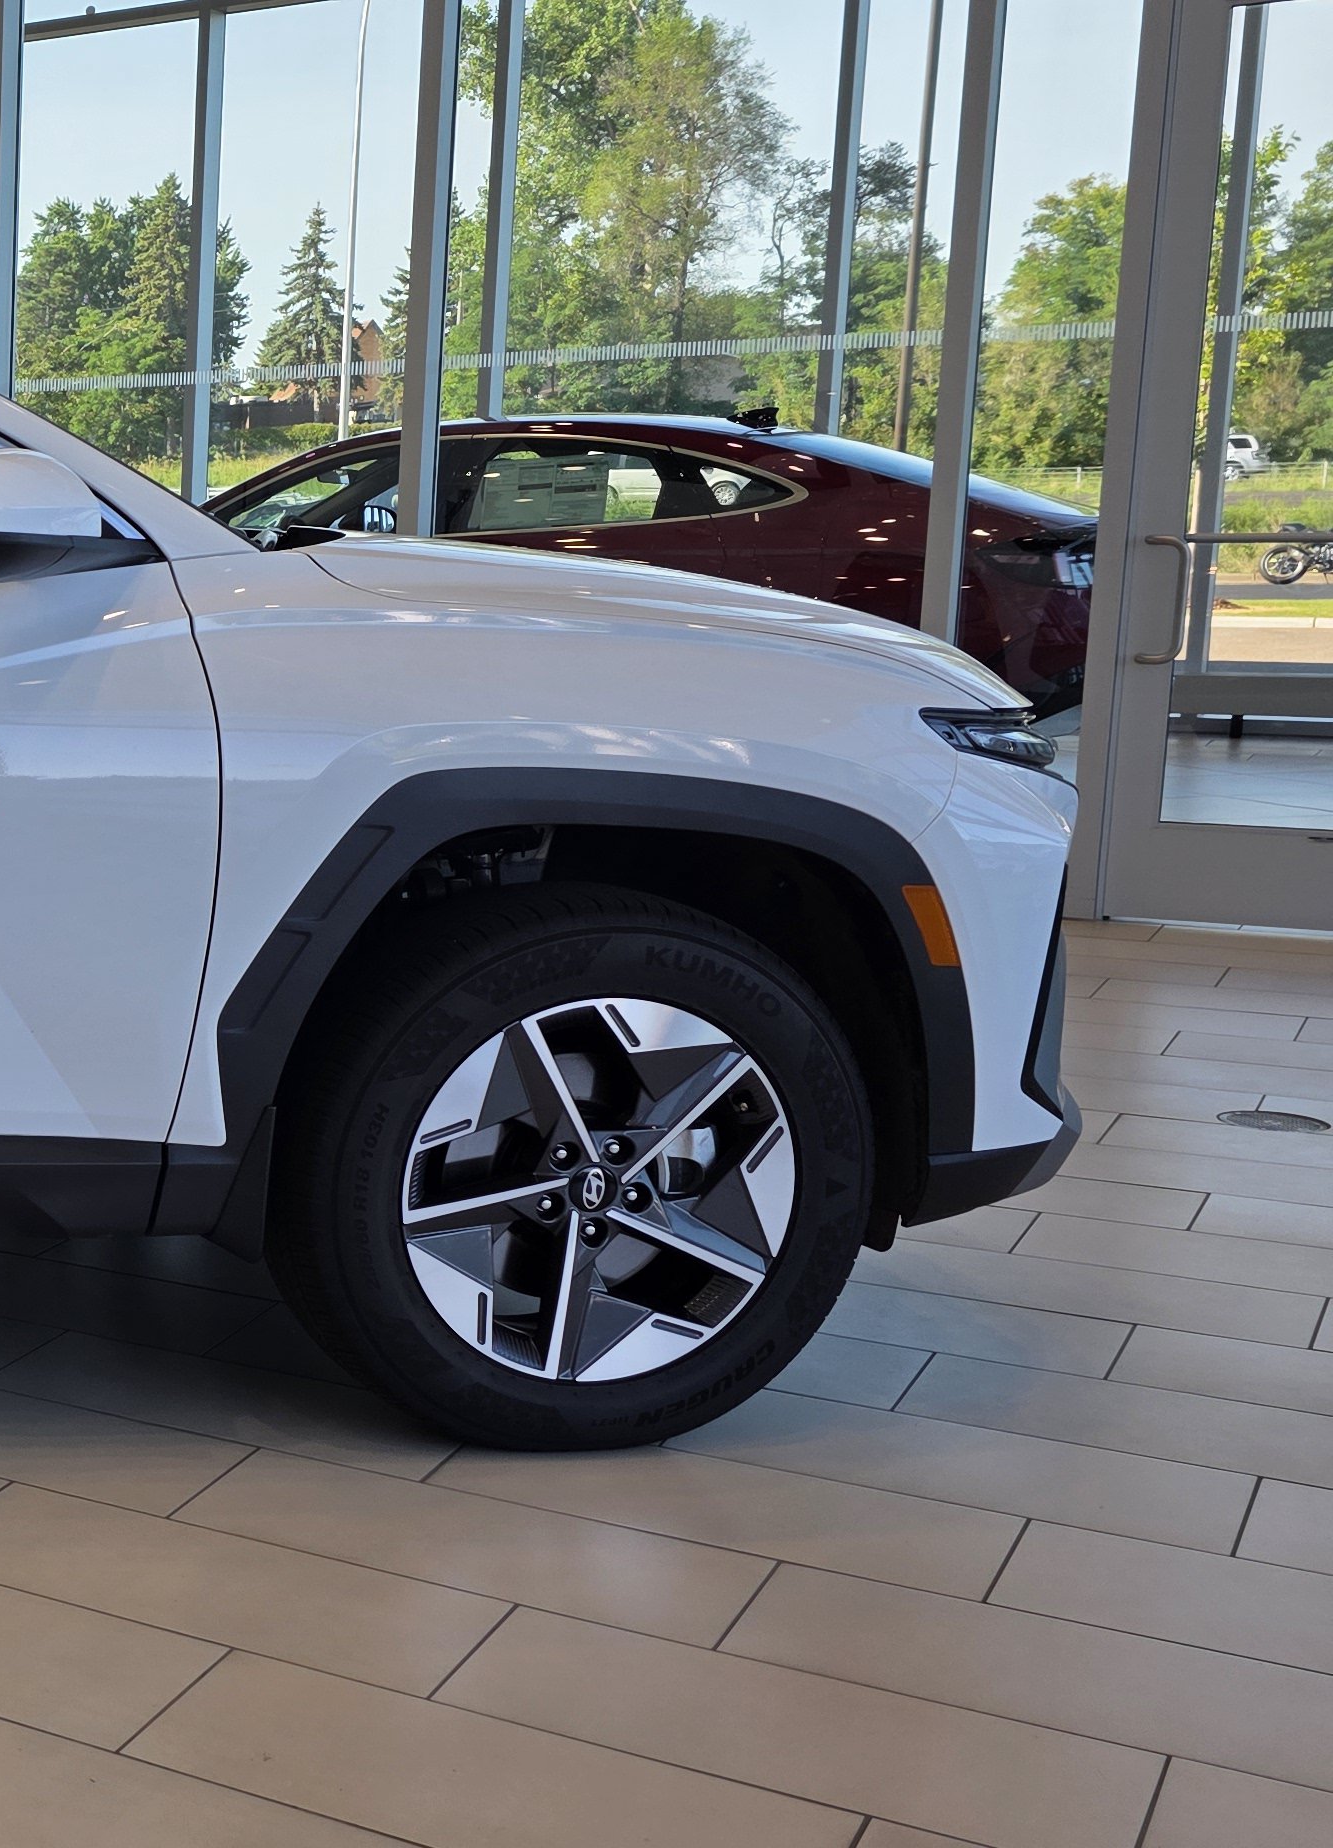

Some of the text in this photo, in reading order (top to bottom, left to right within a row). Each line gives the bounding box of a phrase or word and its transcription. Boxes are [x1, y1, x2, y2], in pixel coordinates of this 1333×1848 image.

[645, 945, 782, 1017] KUMHO
[361, 1102, 390, 1159] 103H
[353, 1167, 370, 1212] R18
[634, 1338, 776, 1427] CRUGEN
